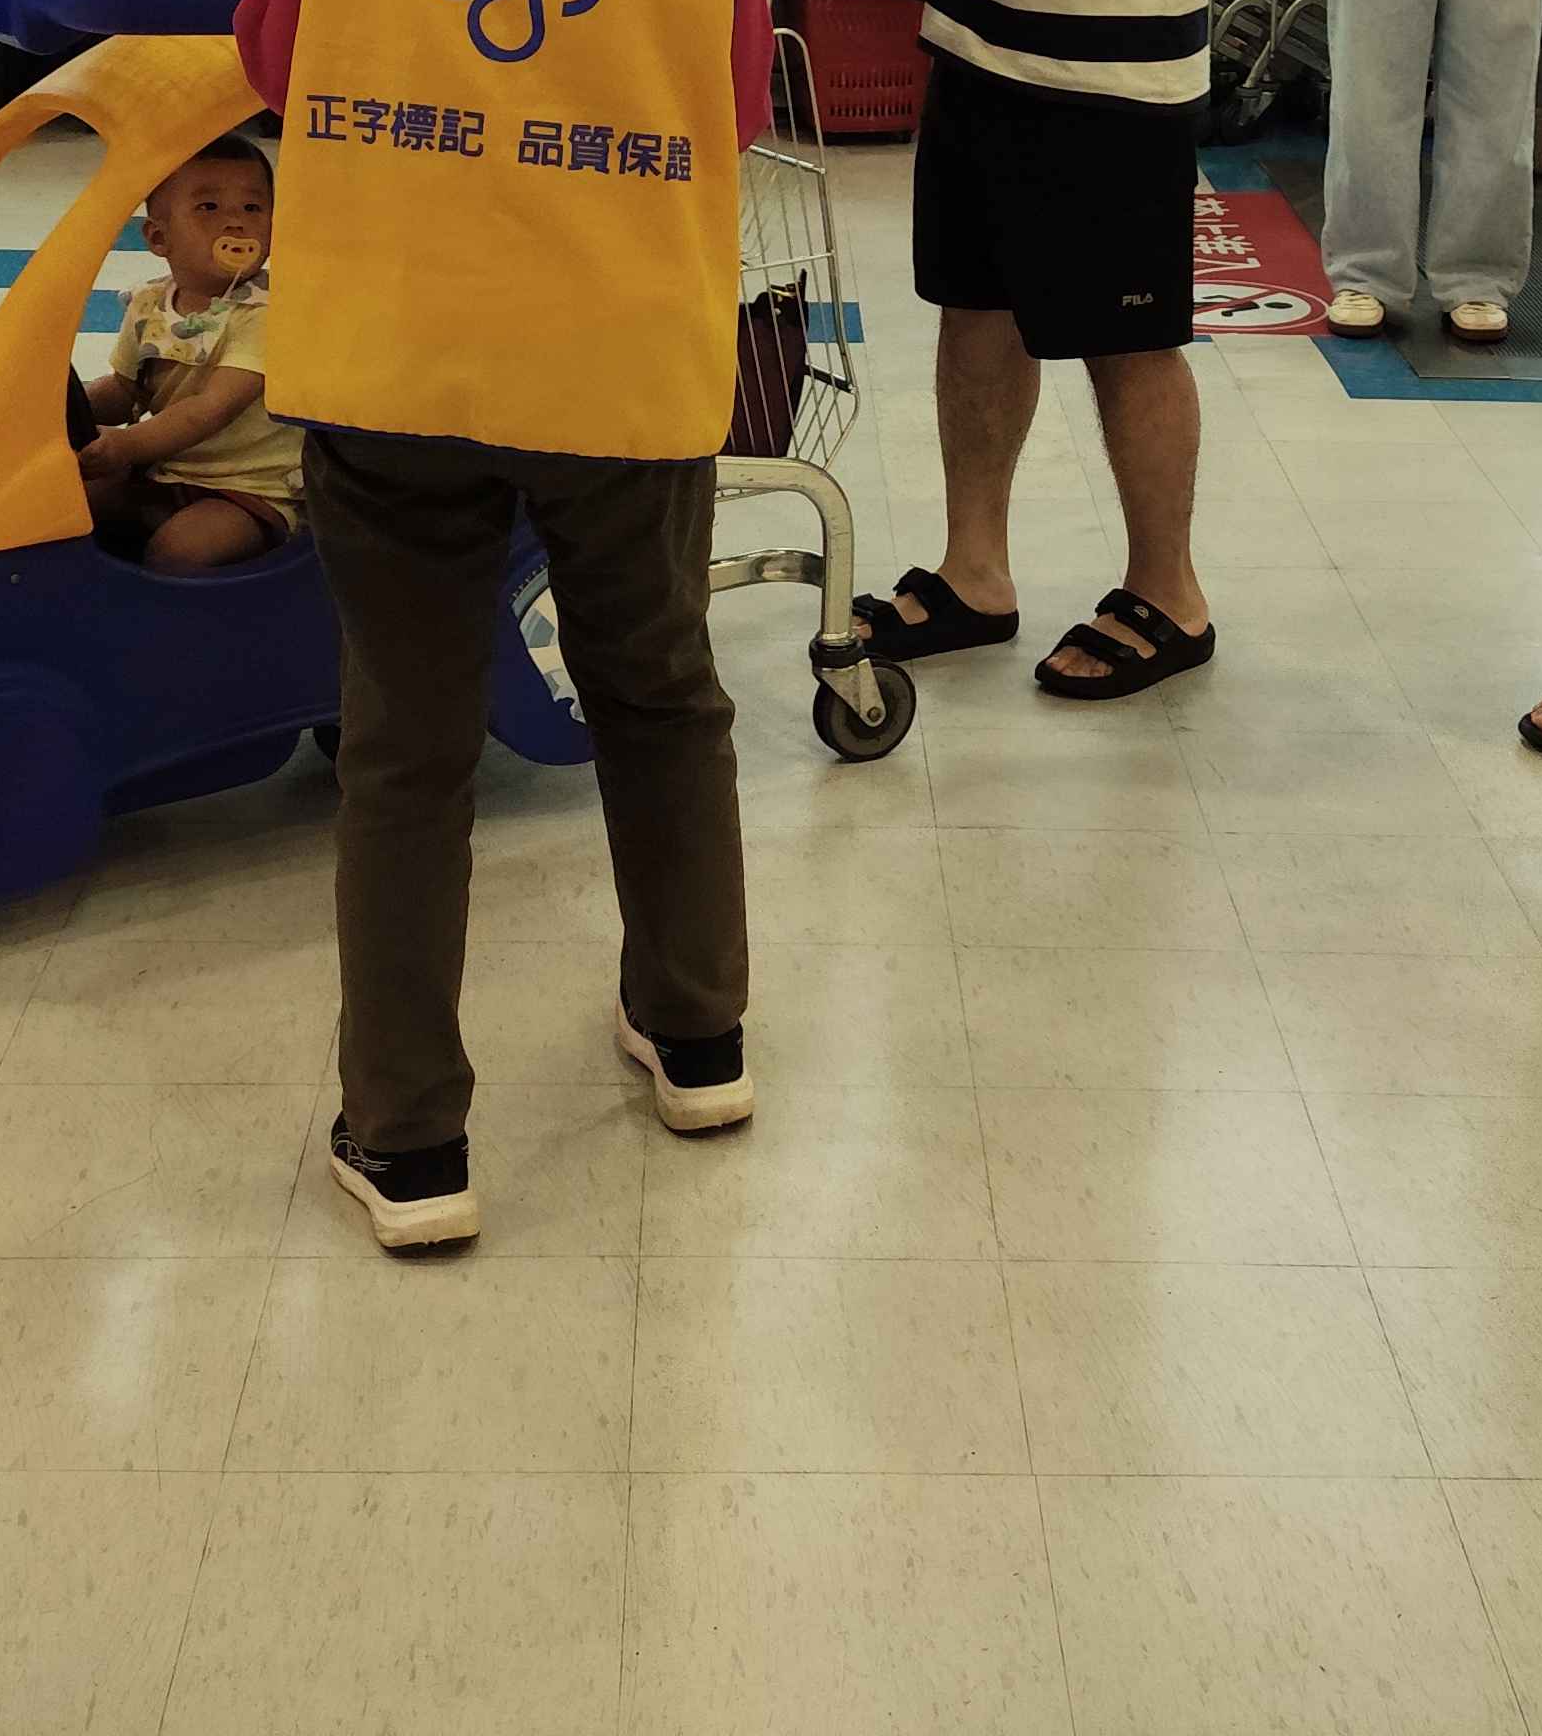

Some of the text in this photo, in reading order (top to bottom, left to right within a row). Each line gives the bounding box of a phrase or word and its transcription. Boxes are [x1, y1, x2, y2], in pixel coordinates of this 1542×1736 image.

[306, 93, 693, 183] 正字標記 品質保證
[1121, 292, 1155, 307] FILA
